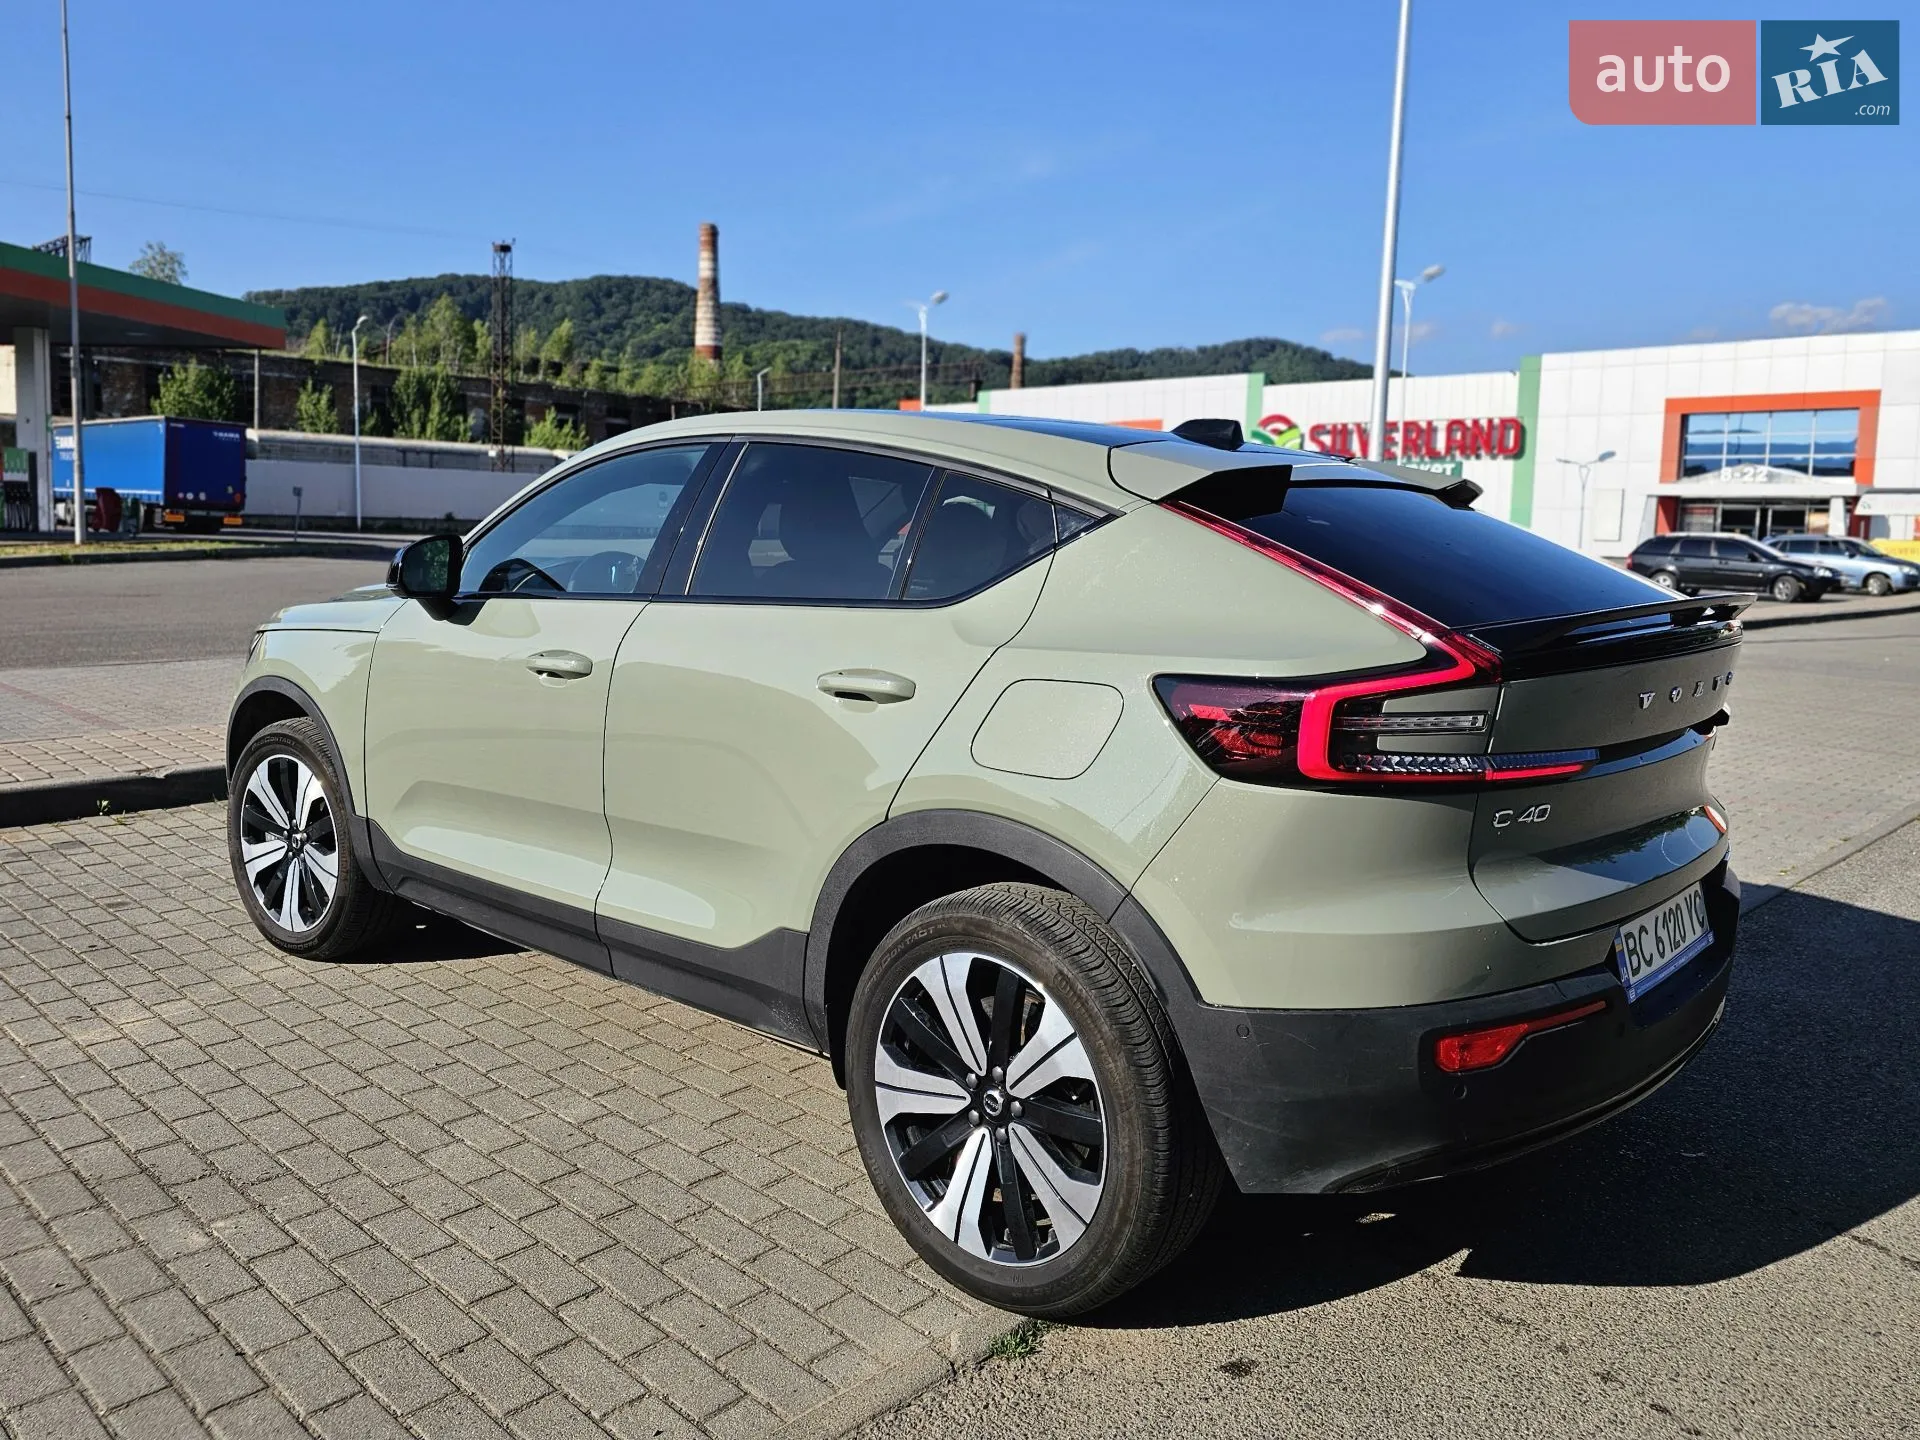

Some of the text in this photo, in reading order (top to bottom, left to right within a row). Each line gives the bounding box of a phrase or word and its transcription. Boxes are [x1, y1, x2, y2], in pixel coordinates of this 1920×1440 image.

[1624, 925, 1654, 977] BC
[1654, 903, 1687, 959] 6120
[1684, 889, 1705, 936] YC
